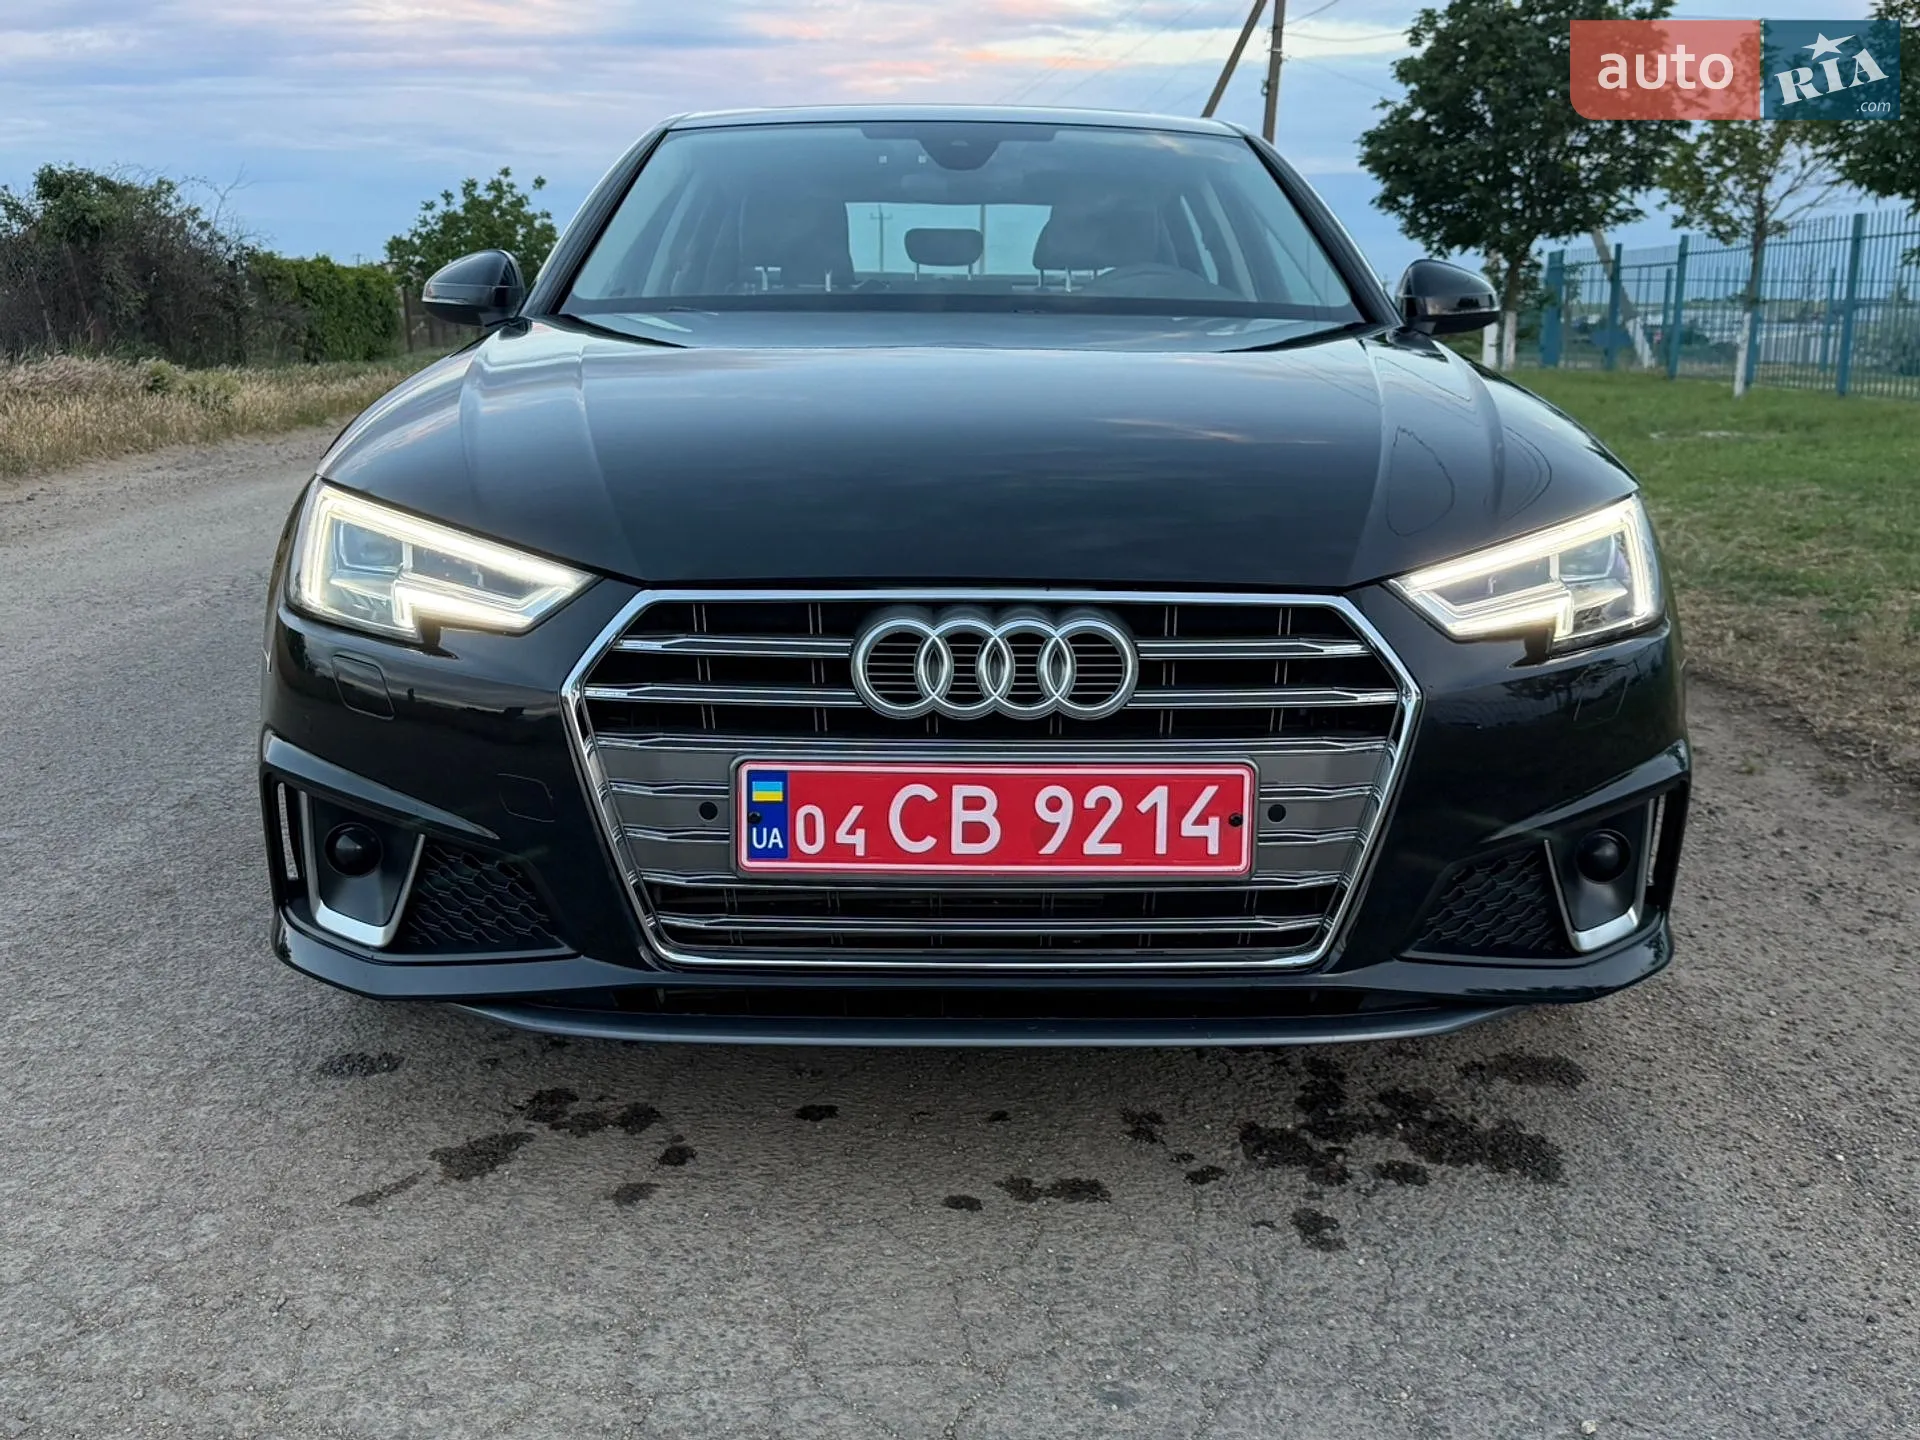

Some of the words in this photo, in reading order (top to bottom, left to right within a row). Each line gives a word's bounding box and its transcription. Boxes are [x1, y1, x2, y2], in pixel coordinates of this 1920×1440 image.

[752, 827, 784, 848] UA
[795, 804, 865, 856] 04
[888, 784, 1001, 854] CB
[1034, 785, 1220, 855] 9214
